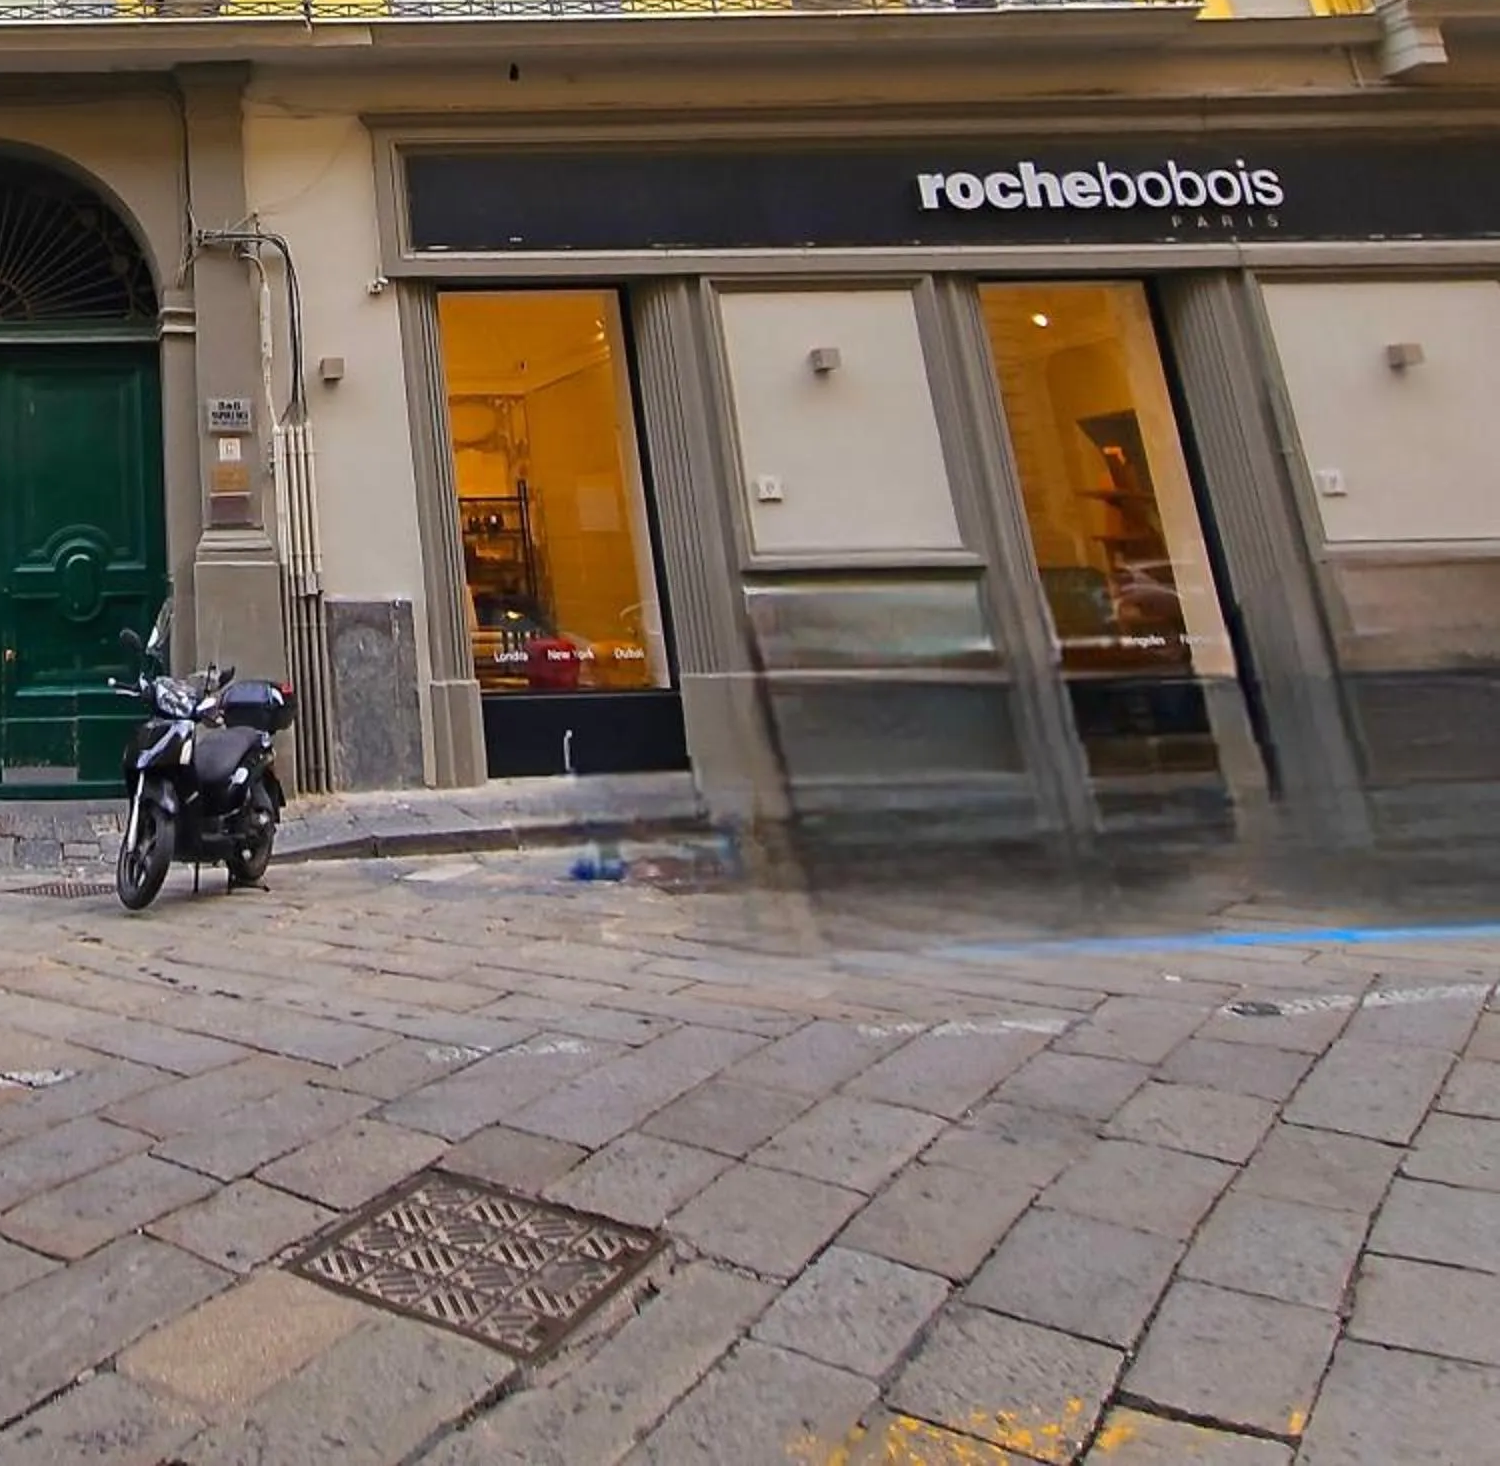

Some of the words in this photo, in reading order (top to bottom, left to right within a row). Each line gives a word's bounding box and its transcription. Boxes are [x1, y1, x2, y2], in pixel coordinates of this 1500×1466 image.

[917, 159, 1284, 210] rochebobois
[1171, 214, 1280, 228] PARIS
[493, 650, 529, 663] Londra
[547, 648, 571, 661] New
